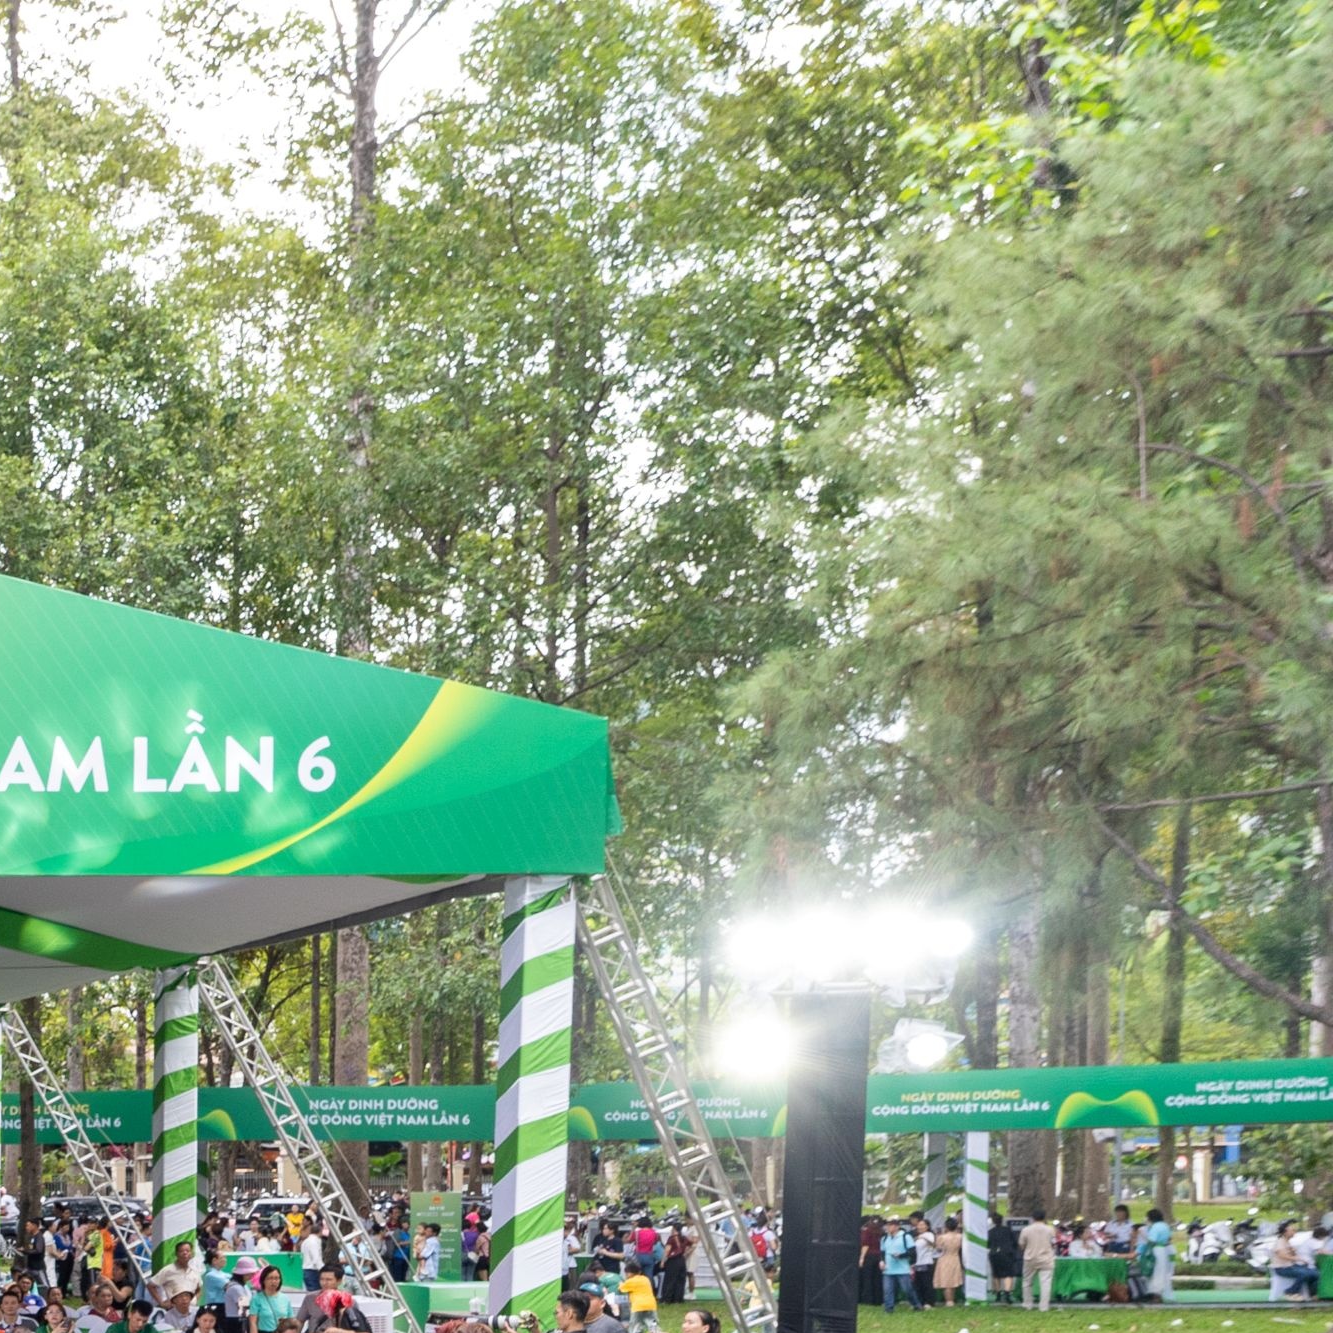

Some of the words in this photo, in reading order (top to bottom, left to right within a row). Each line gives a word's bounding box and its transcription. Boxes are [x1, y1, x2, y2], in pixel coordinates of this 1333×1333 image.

[133, 709, 275, 793] LẦN
[296, 735, 337, 793] 6
[309, 1098, 346, 1111] NGÀY
[348, 1099, 384, 1110] DINH
[387, 1097, 439, 1110] DƯỠNG
[1041, 1101, 1050, 1110] 6
[86, 1113, 111, 1129] LẦN
[113, 1116, 122, 1129] 6
[365, 1112, 394, 1128] VIỆT
[397, 1114, 429, 1125] NAM
[432, 1111, 460, 1125] LẦN
[462, 1114, 471, 1125] 6
[760, 1109, 768, 1119] 6
